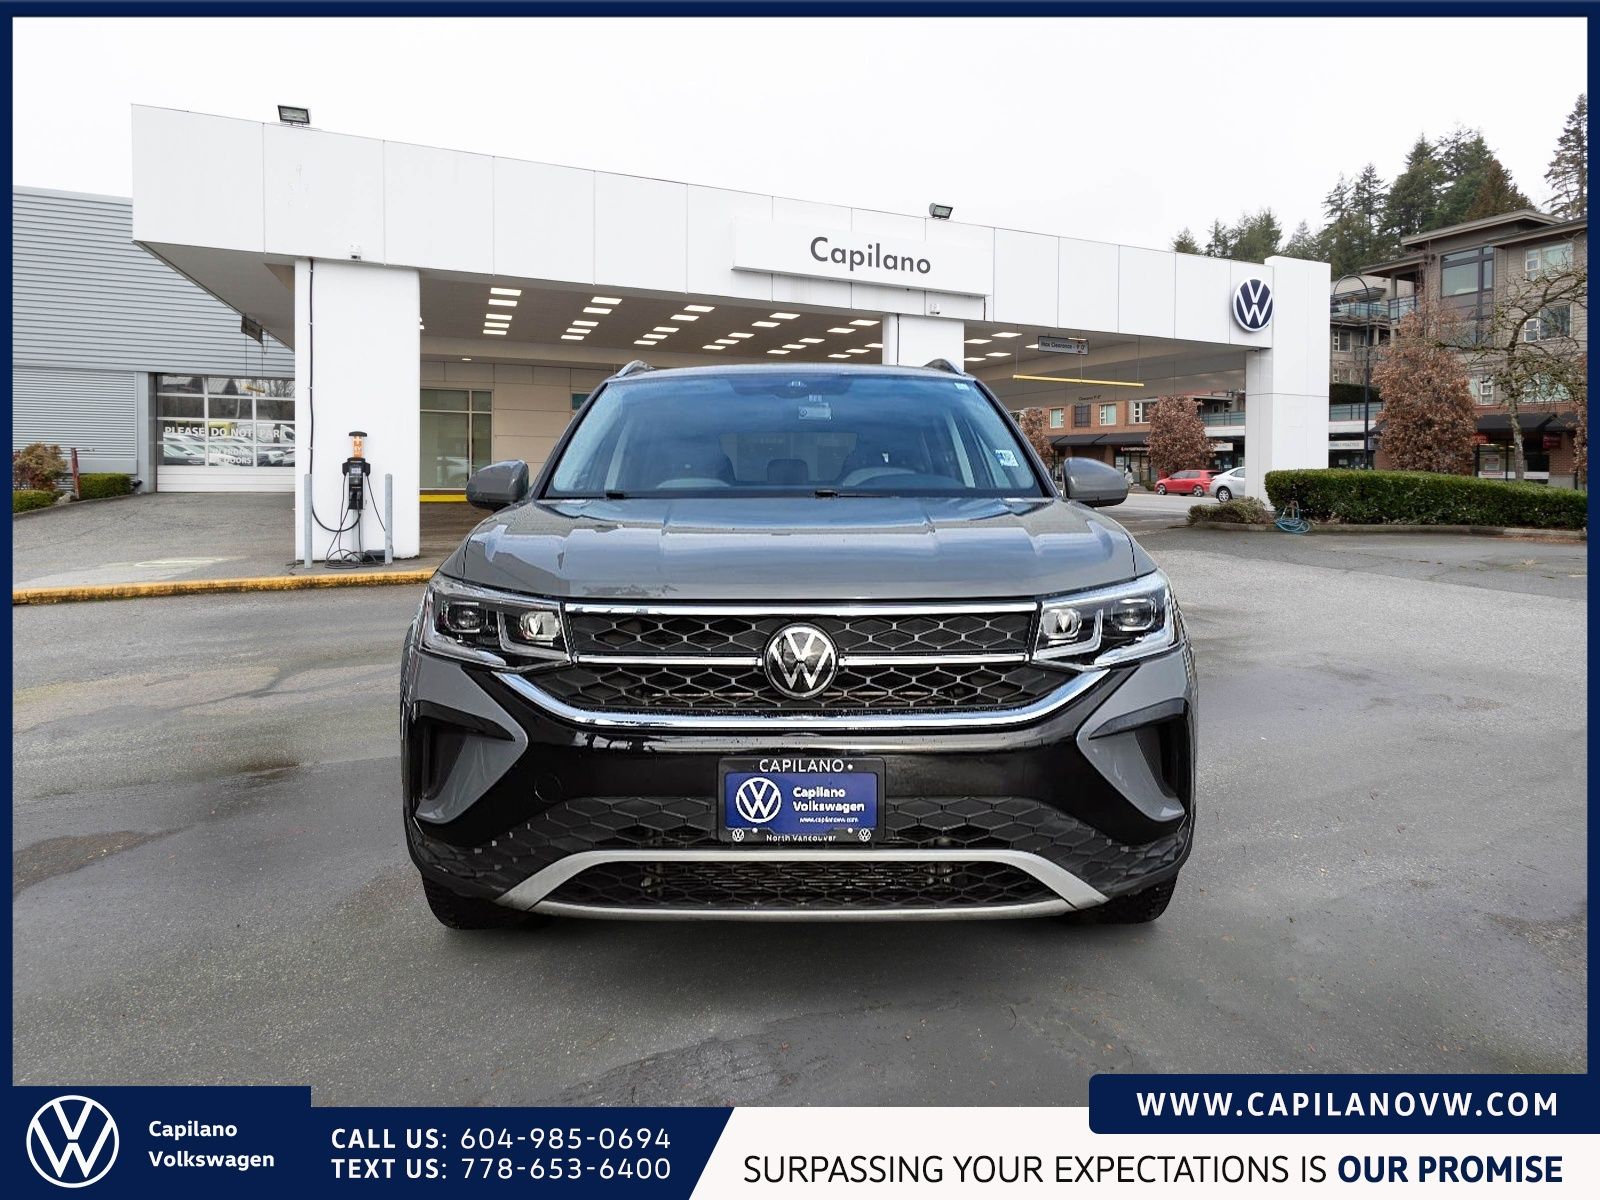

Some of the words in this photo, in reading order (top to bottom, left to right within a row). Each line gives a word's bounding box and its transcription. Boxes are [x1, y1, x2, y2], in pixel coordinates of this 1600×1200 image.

[810, 236, 931, 275] Capilano
[1234, 278, 1273, 330] VW
[165, 426, 205, 436] PLEASE
[211, 427, 227, 437] DO
[230, 428, 254, 438] NOT
[759, 758, 844, 773] CAPILANO
[792, 786, 846, 800] Capilano
[736, 778, 781, 823] VW
[792, 800, 865, 814] Volkswagen
[766, 833, 791, 842] North
[792, 834, 837, 842] Vancouver
